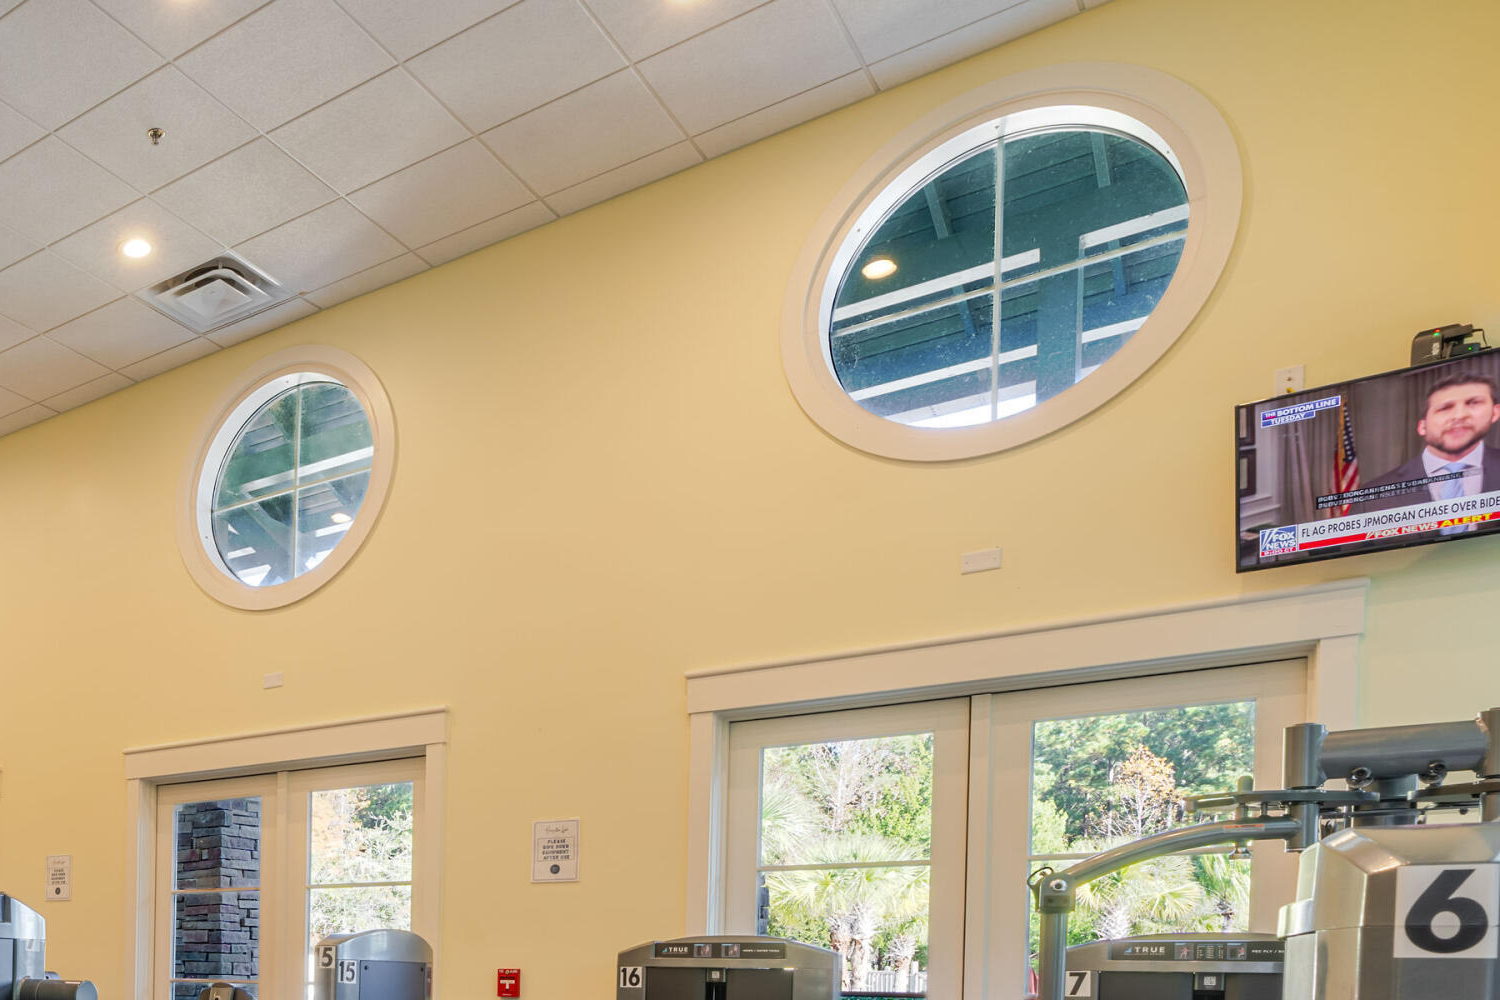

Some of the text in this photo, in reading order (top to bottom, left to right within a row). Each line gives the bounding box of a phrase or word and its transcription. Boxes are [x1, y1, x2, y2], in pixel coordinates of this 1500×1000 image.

[1277, 404, 1314, 417] BOTTOM
[1315, 398, 1337, 409] LINE
[1271, 412, 1306, 425] TUESDAY
[1301, 528, 1310, 538] FL
[1312, 525, 1326, 536] AG
[1327, 519, 1361, 534] PROBES
[1363, 510, 1416, 528] JPMORGAN
[1418, 504, 1449, 519] CHASE
[1451, 500, 1477, 514] OVER
[1373, 512, 1493, 539] FOX NEWS ALERT
[1265, 540, 1296, 551] NEWS
[1273, 531, 1296, 541] FOX
[1405, 869, 1489, 954] 6
[339, 961, 355, 982] 15
[620, 967, 641, 987] 16
[1068, 972, 1087, 995] 7
